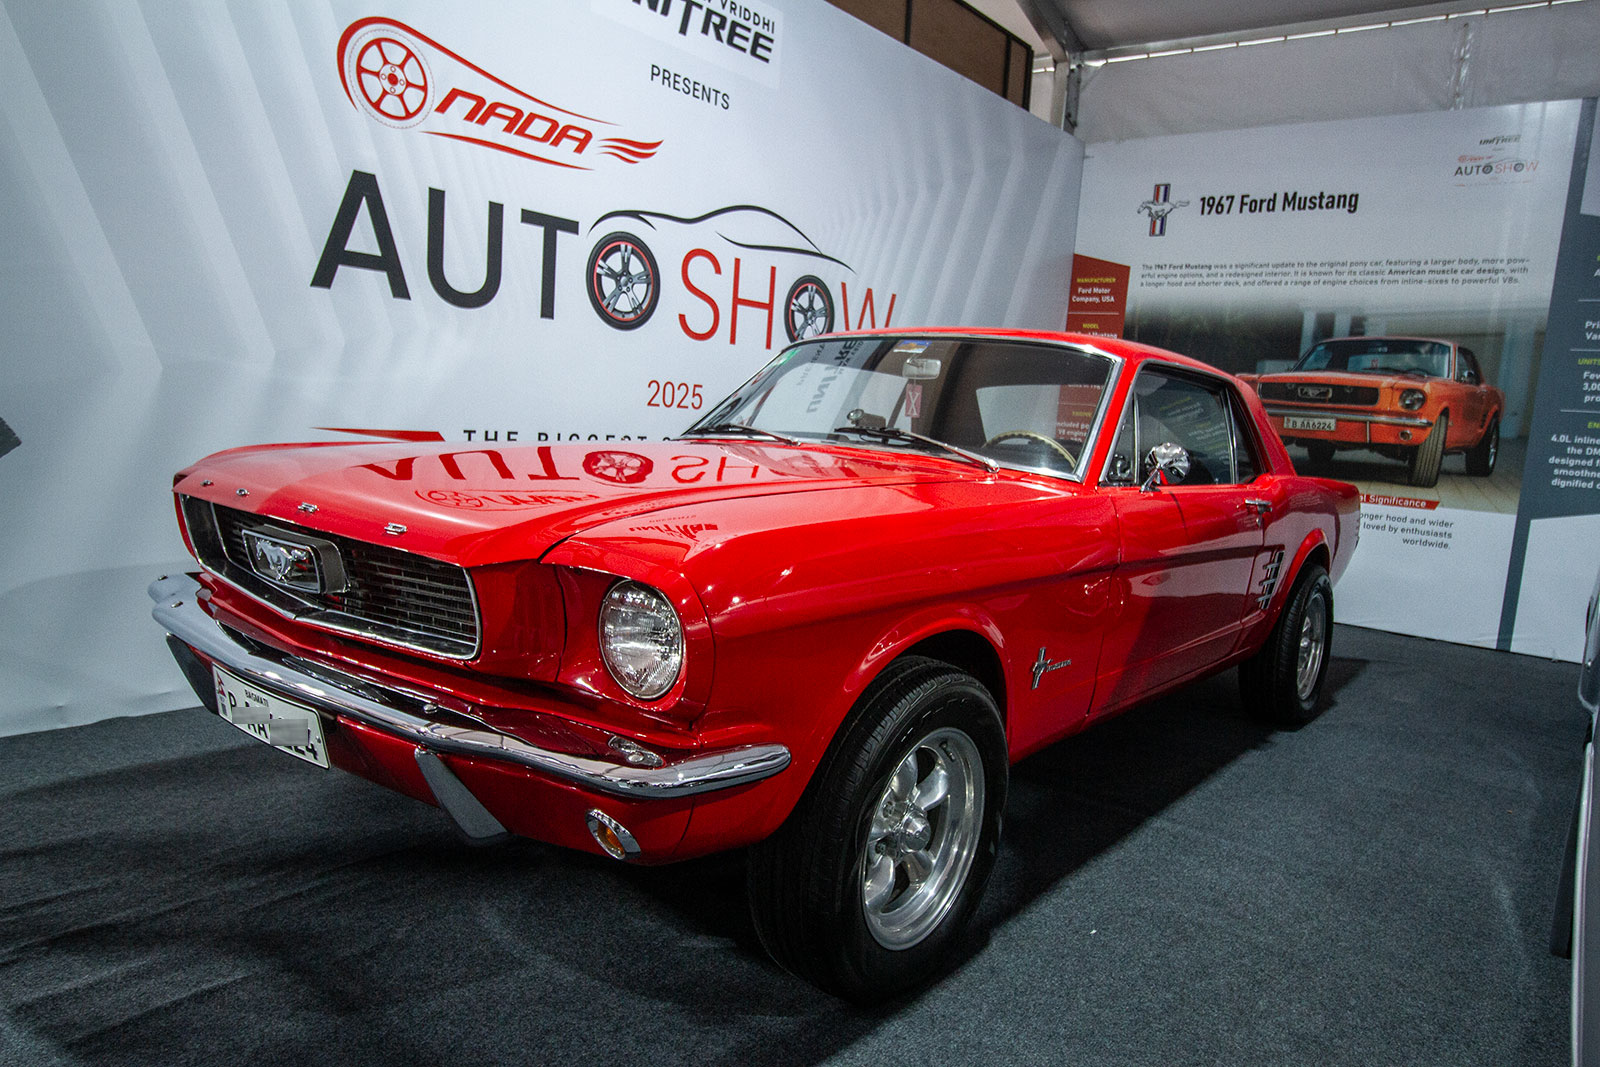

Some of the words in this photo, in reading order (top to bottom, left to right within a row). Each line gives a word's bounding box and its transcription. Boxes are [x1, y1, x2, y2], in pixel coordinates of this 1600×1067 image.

[650, 63, 730, 111] PRESENTS
[434, 87, 594, 154] NADA
[1200, 195, 1235, 216] 1967
[1239, 194, 1277, 214] Ford
[1281, 190, 1360, 213] Mustang
[1185, 263, 1212, 272] Mustang
[1235, 262, 1270, 272] significant
[1272, 262, 1295, 270] update
[1320, 260, 1348, 270] original
[1386, 258, 1421, 268] featuring
[1430, 258, 1456, 267] larger
[1458, 258, 1480, 266] body,
[1146, 280, 1166, 288] longer
[1323, 278, 1347, 286] engine
[1462, 276, 1500, 285] powerful
[1158, 272, 1178, 280] engine
[1226, 270, 1263, 280] redesigned
[647, 379, 703, 410] 2025
[1551, 434, 1572, 444] 4.0L
[1566, 446, 1582, 455] the
[1548, 456, 1592, 467] designed
[1551, 478, 1592, 488] dignified
[1370, 494, 1426, 508] Significance
[1386, 514, 1407, 524] hood
[1410, 518, 1426, 526] and
[1428, 519, 1454, 528] wider
[1363, 522, 1386, 530] loved
[1388, 524, 1398, 534] by
[1400, 527, 1452, 539] enthusiasts
